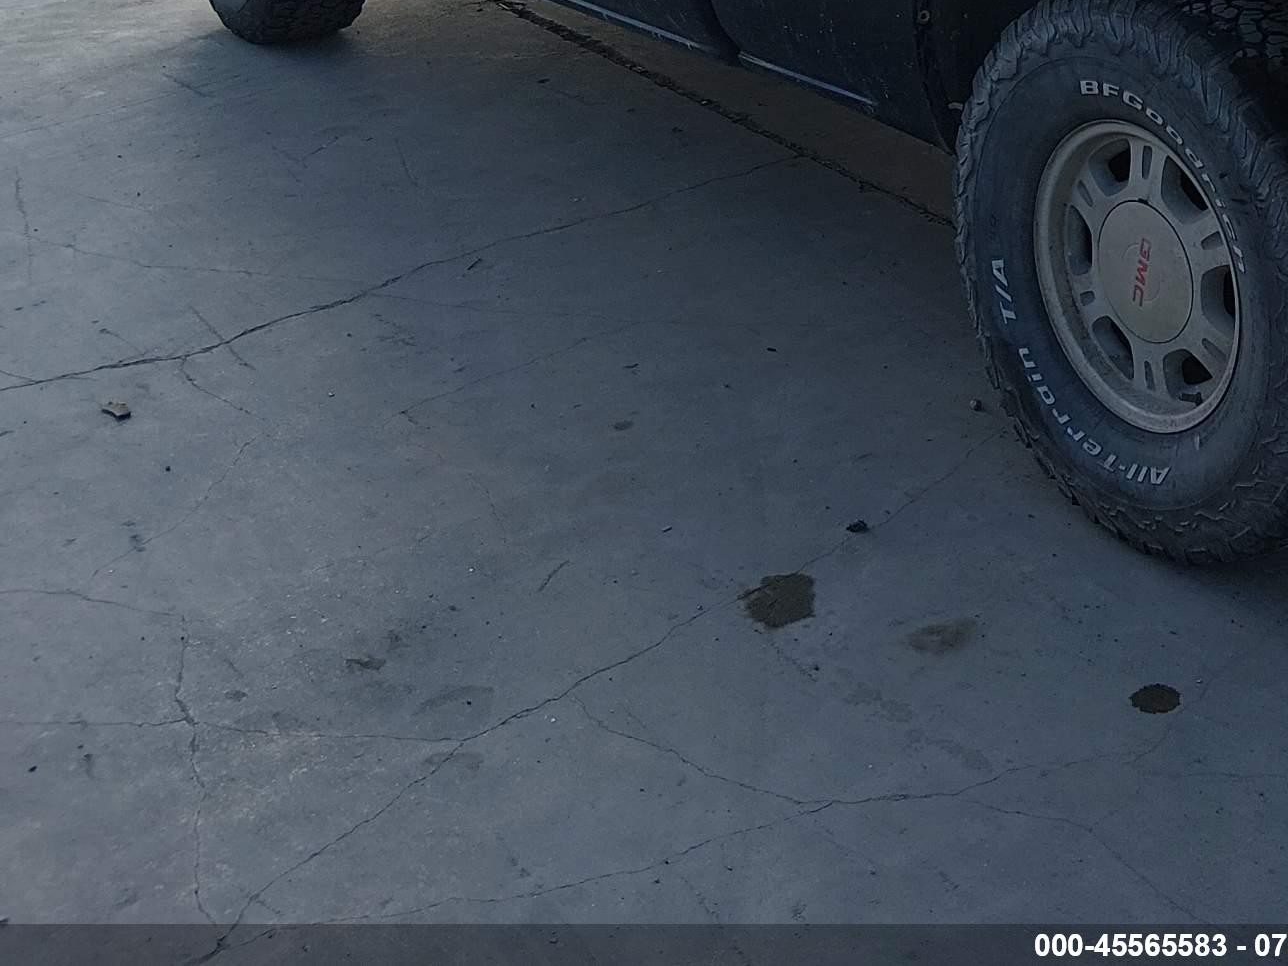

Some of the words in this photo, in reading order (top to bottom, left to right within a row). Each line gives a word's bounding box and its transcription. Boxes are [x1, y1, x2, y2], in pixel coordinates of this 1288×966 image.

[992, 259, 1017, 325] T/A
[1132, 238, 1151, 307] GMC
[1019, 347, 1172, 485] All-Terrain
